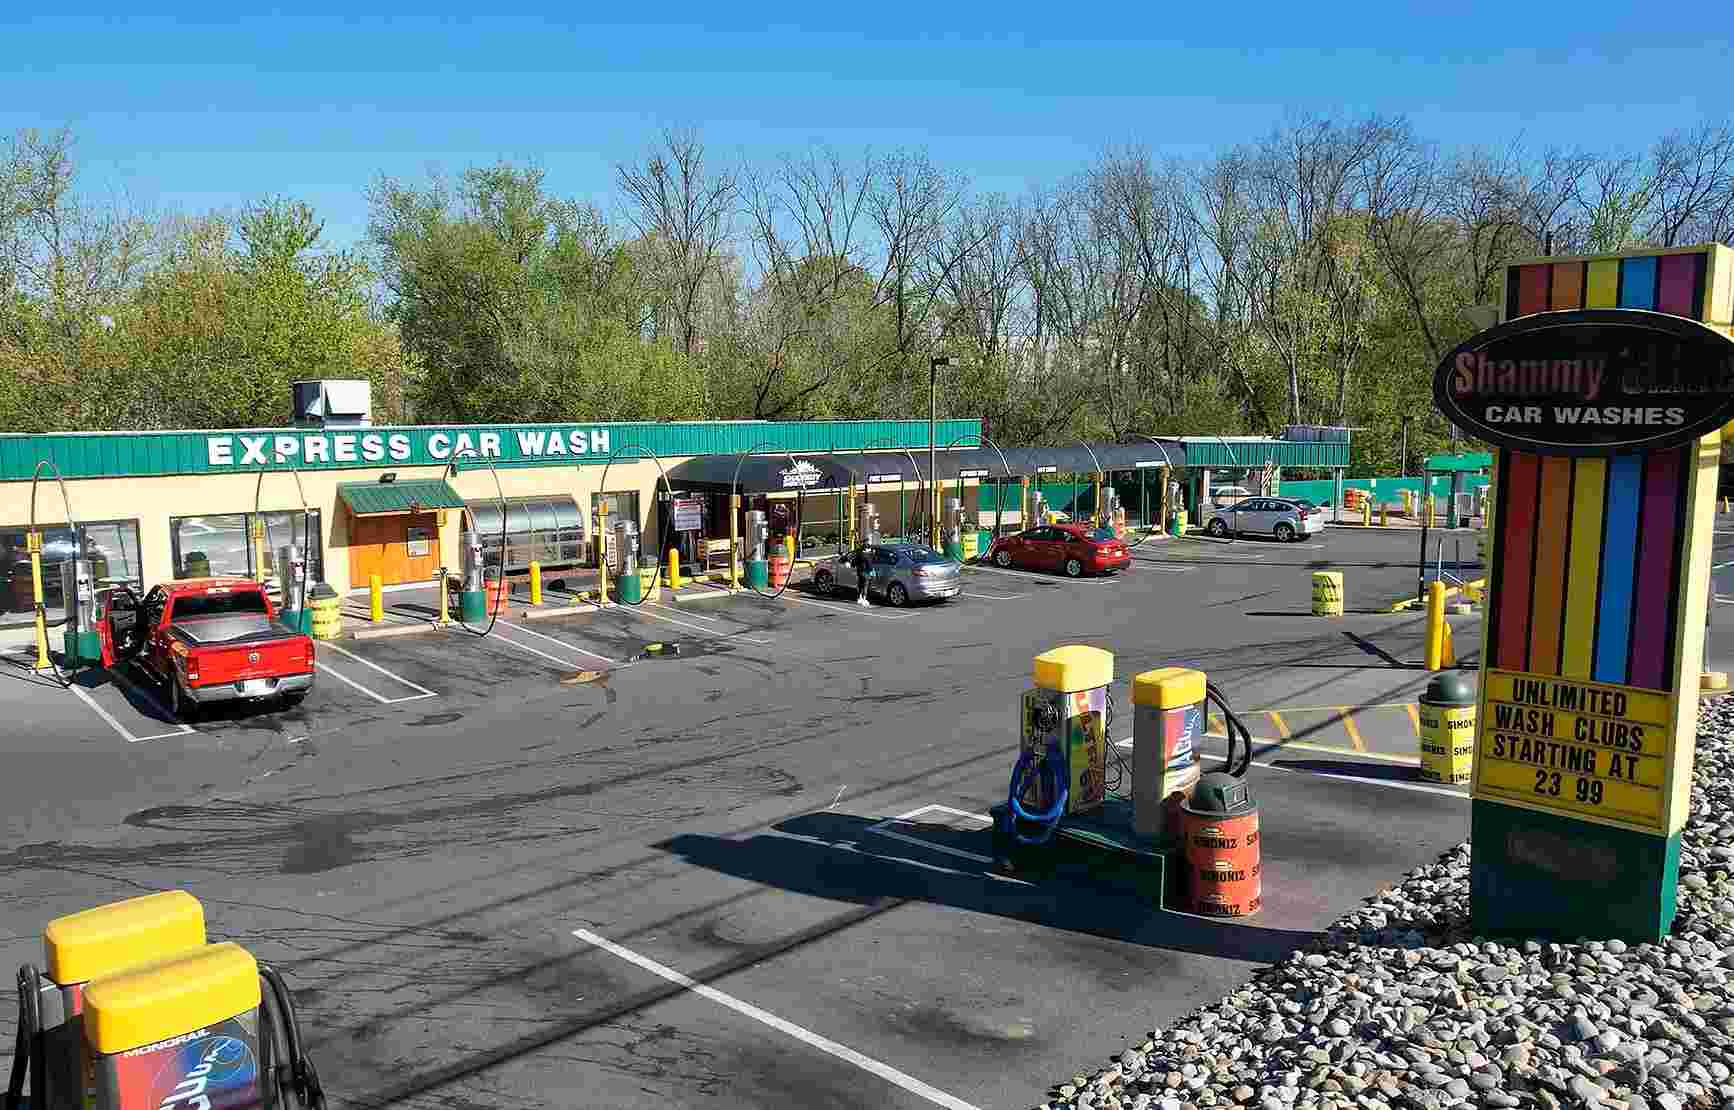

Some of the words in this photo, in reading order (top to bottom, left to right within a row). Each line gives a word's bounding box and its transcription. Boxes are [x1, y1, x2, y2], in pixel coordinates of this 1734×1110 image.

[1456, 351, 1606, 400] Shammy
[1484, 405, 1543, 424] CAR
[1551, 406, 1686, 425] WASHES
[207, 433, 412, 465] EXPRESS
[428, 431, 501, 460] CAR
[516, 429, 611, 457] WASH
[1511, 678, 1627, 717] UNLIMITED
[1495, 704, 1554, 737] WASH
[1574, 717, 1645, 754] CLUBS
[1493, 733, 1597, 777] STARTING
[1607, 753, 1640, 782] AT
[1533, 770, 1562, 796] 23
[1575, 777, 1604, 805] 99
[122, 1028, 211, 1058] MONORAIL
